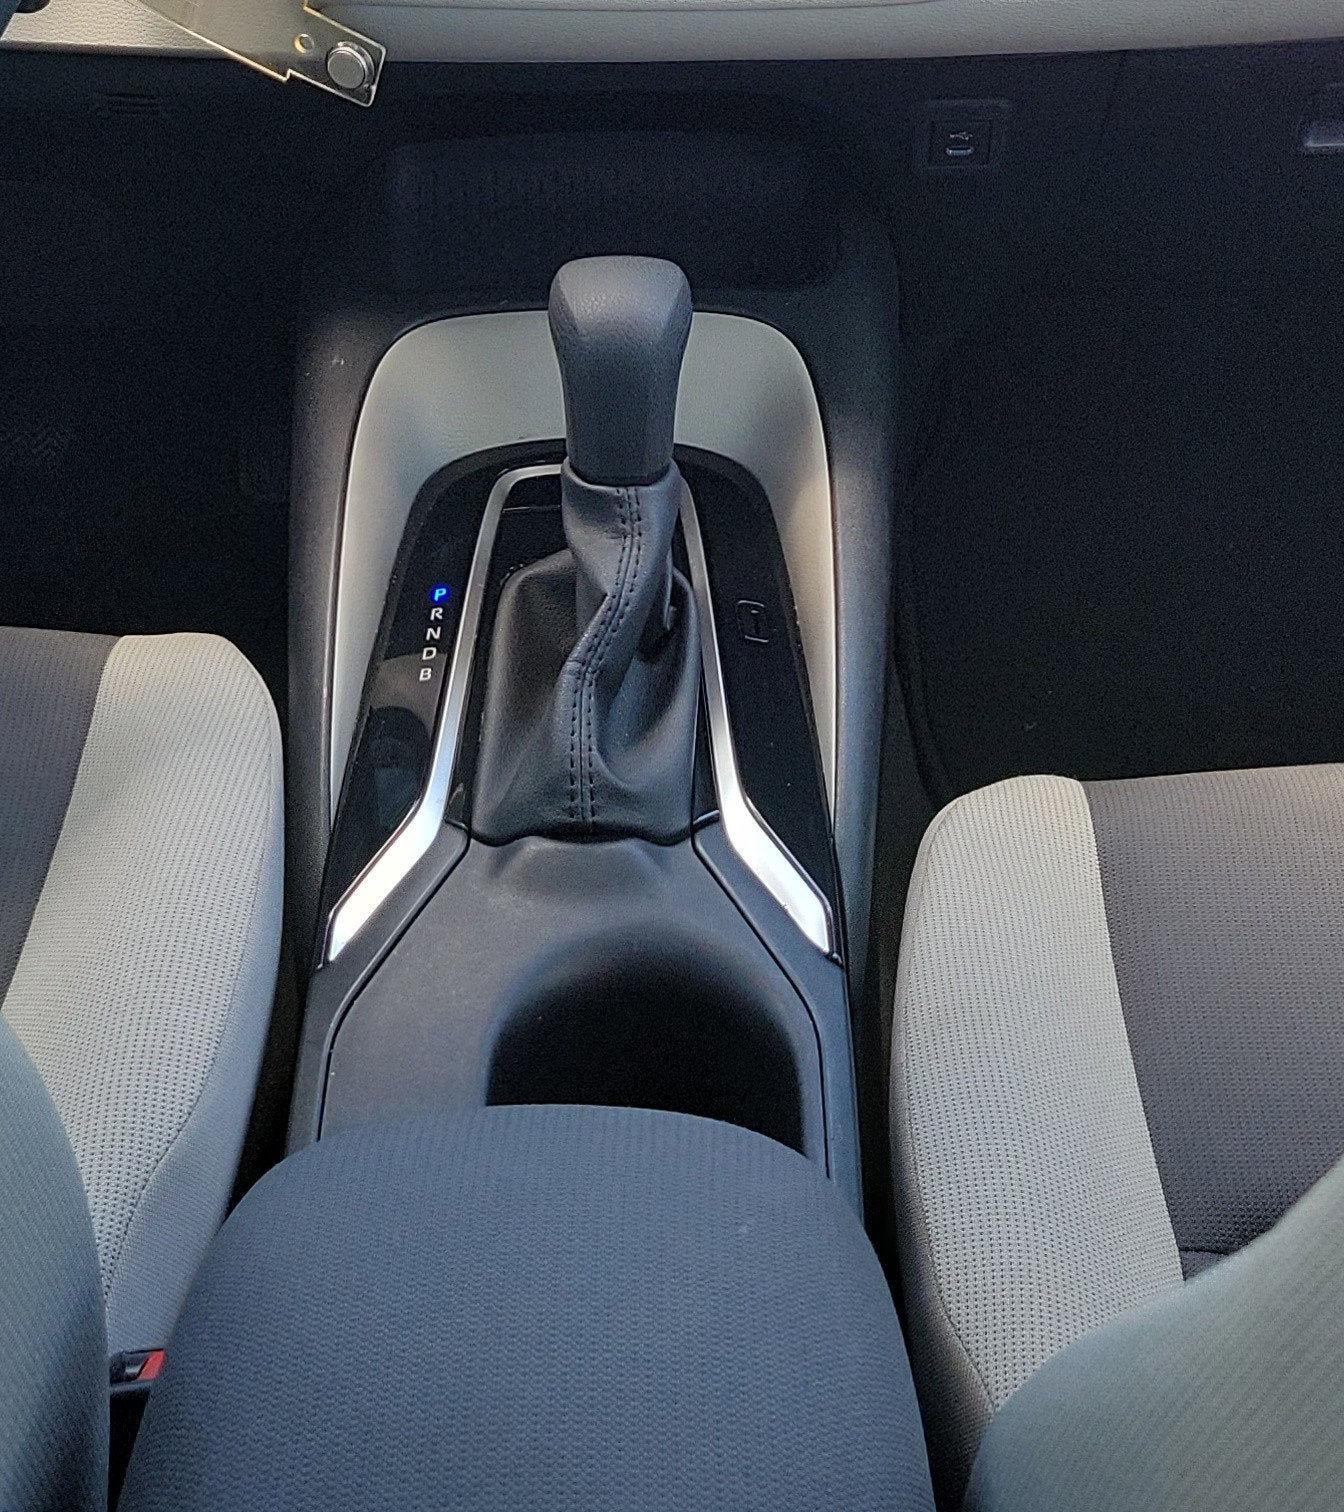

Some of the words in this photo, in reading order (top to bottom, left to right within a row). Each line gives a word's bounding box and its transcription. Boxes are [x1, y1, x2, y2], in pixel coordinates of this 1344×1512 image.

[434, 588, 447, 602] P
[430, 607, 443, 621] R
[425, 626, 441, 641] N
[421, 646, 437, 661] D
[418, 667, 432, 682] B
